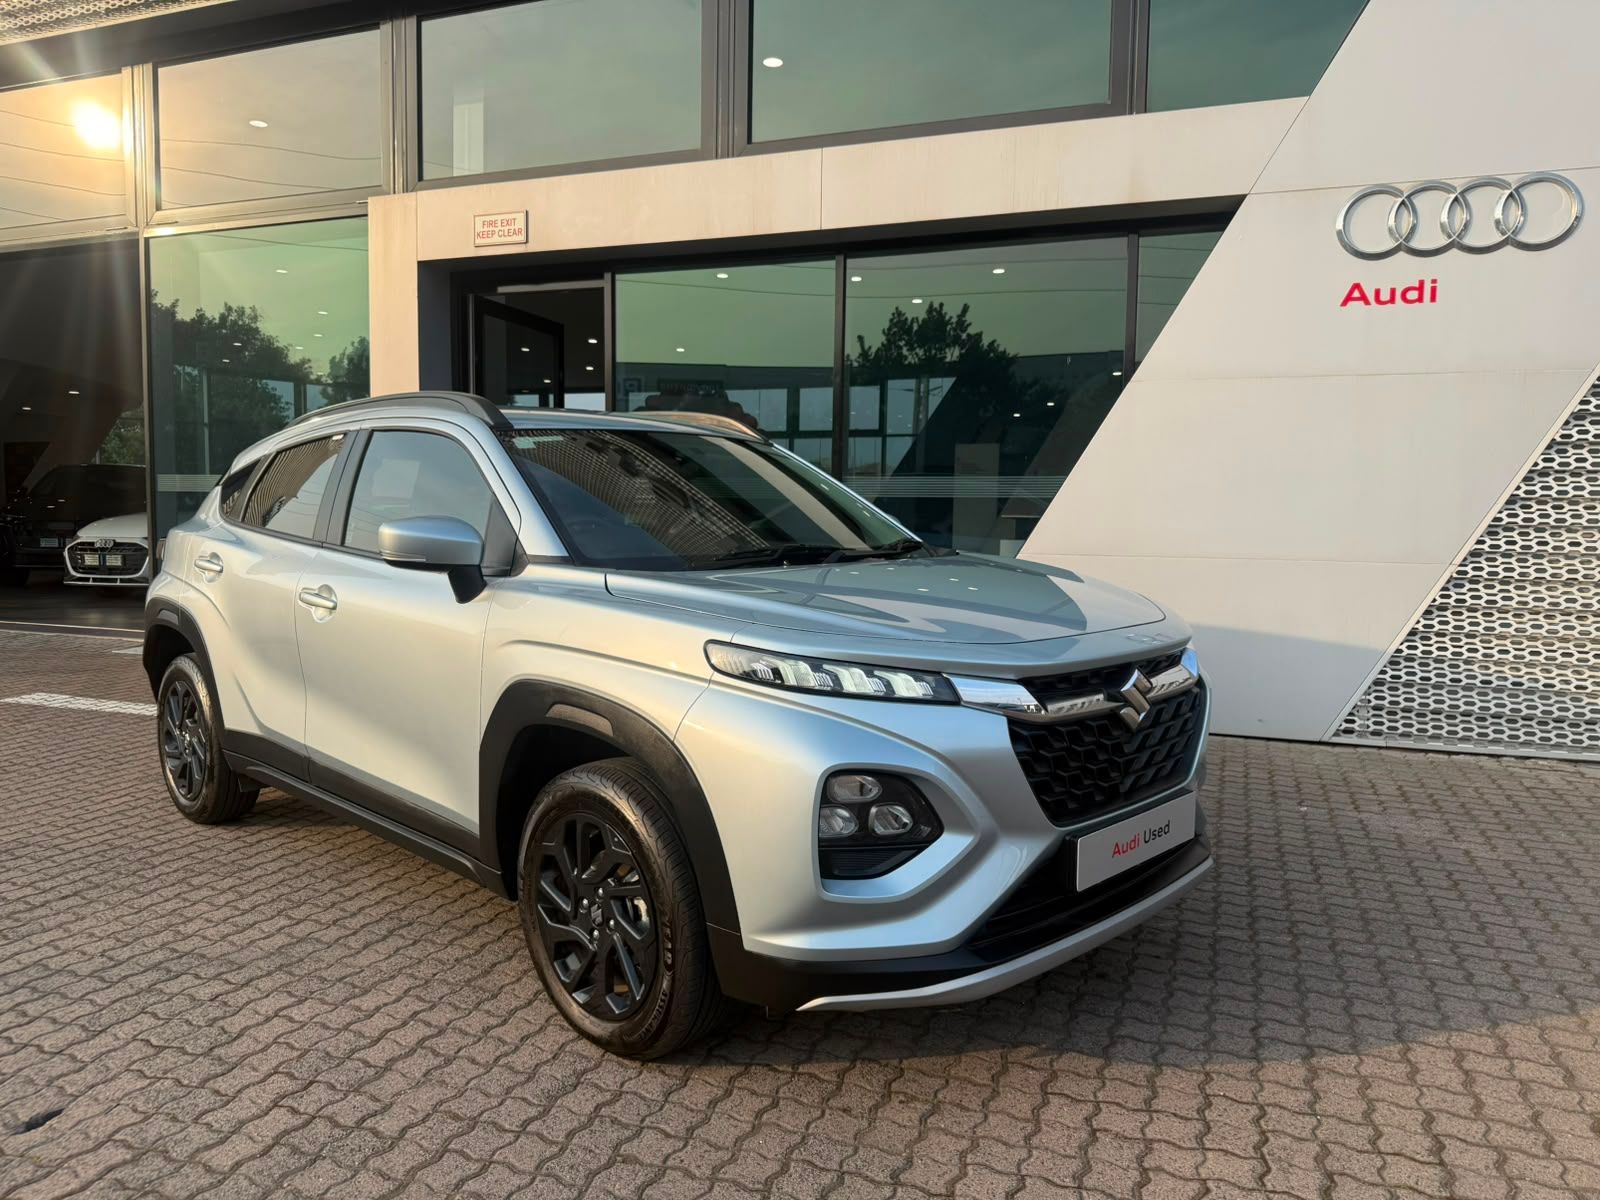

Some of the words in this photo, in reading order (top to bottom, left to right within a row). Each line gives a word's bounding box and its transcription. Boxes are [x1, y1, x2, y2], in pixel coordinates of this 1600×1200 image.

[476, 230, 496, 239] KEEP
[497, 228, 523, 237] CLEAR
[482, 220, 498, 229] FIRE
[500, 218, 517, 227] EXIT
[1339, 278, 1438, 307] Audi
[1111, 832, 1141, 858] Audi
[1143, 819, 1171, 844] Used
